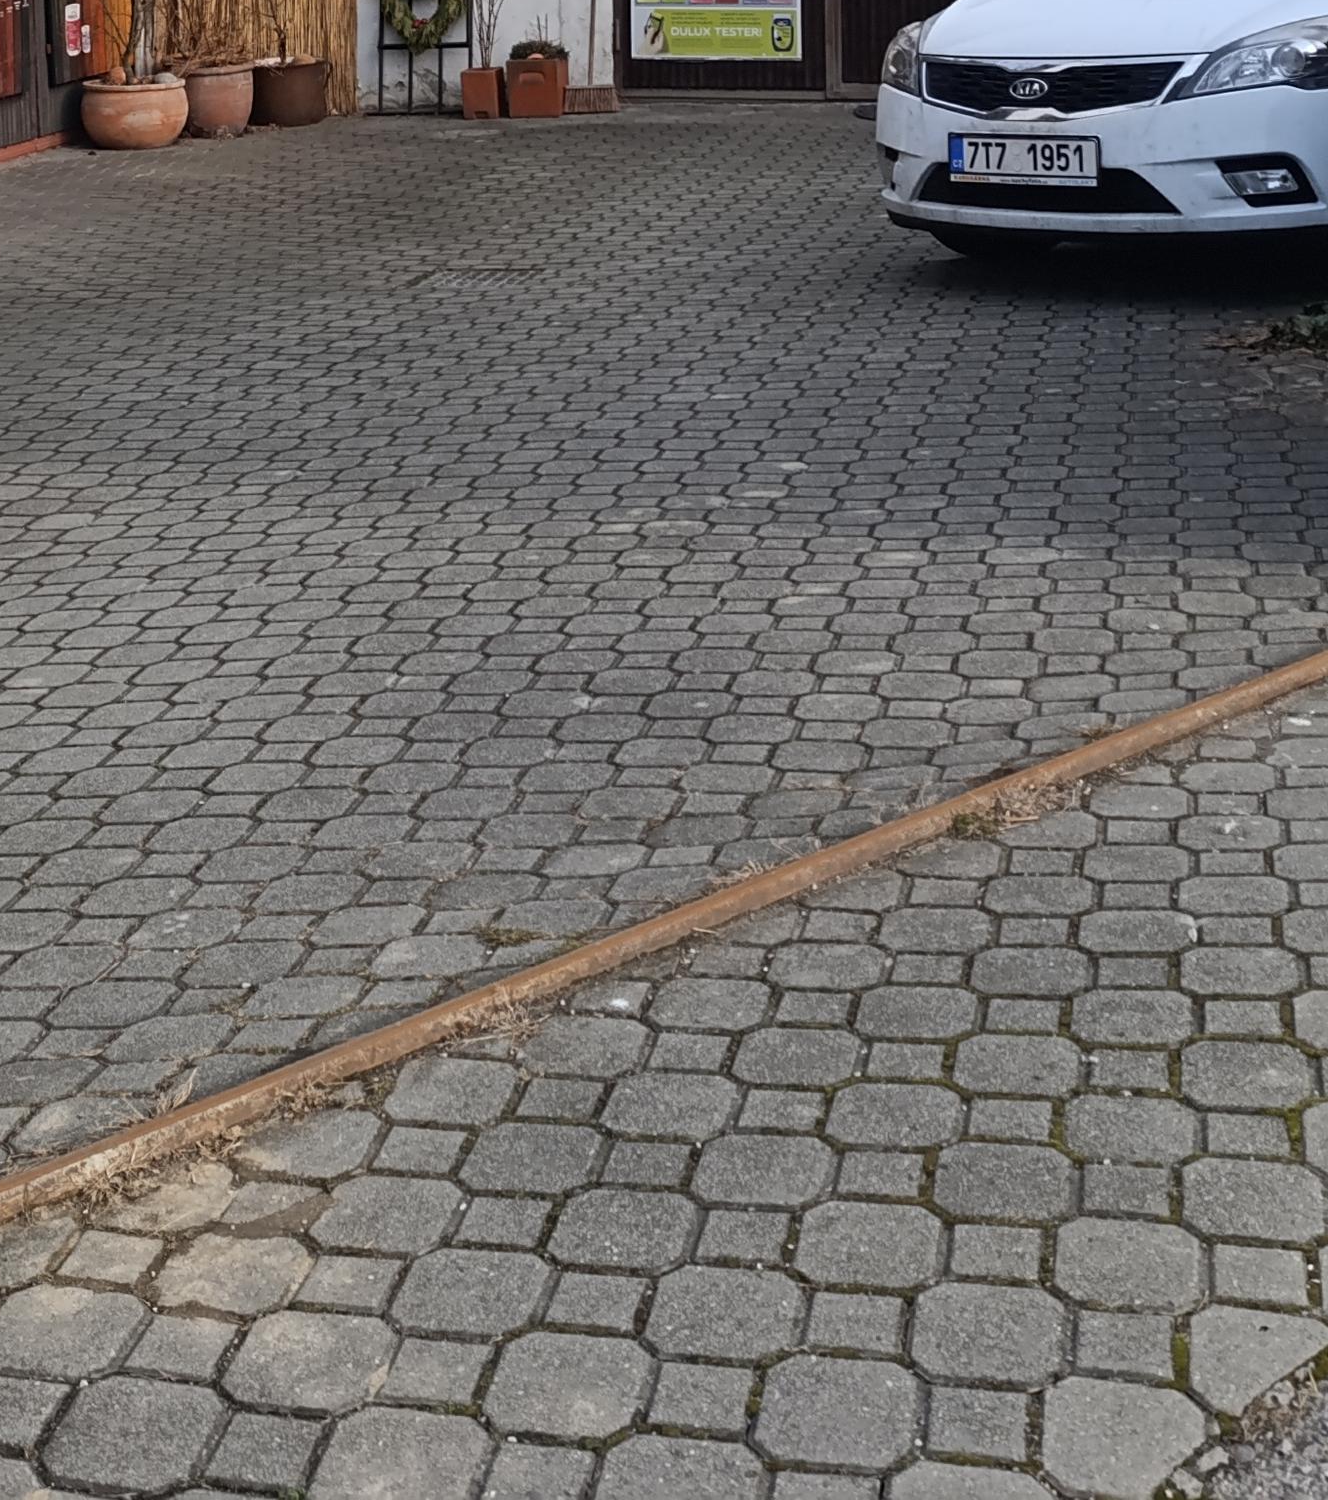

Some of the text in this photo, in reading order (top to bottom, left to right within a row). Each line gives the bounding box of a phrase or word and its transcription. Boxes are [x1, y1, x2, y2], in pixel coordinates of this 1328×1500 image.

[671, 27, 763, 37] DULUX TESTER!
[967, 141, 1084, 173] 7T7 1951
[952, 159, 963, 168] CZ
